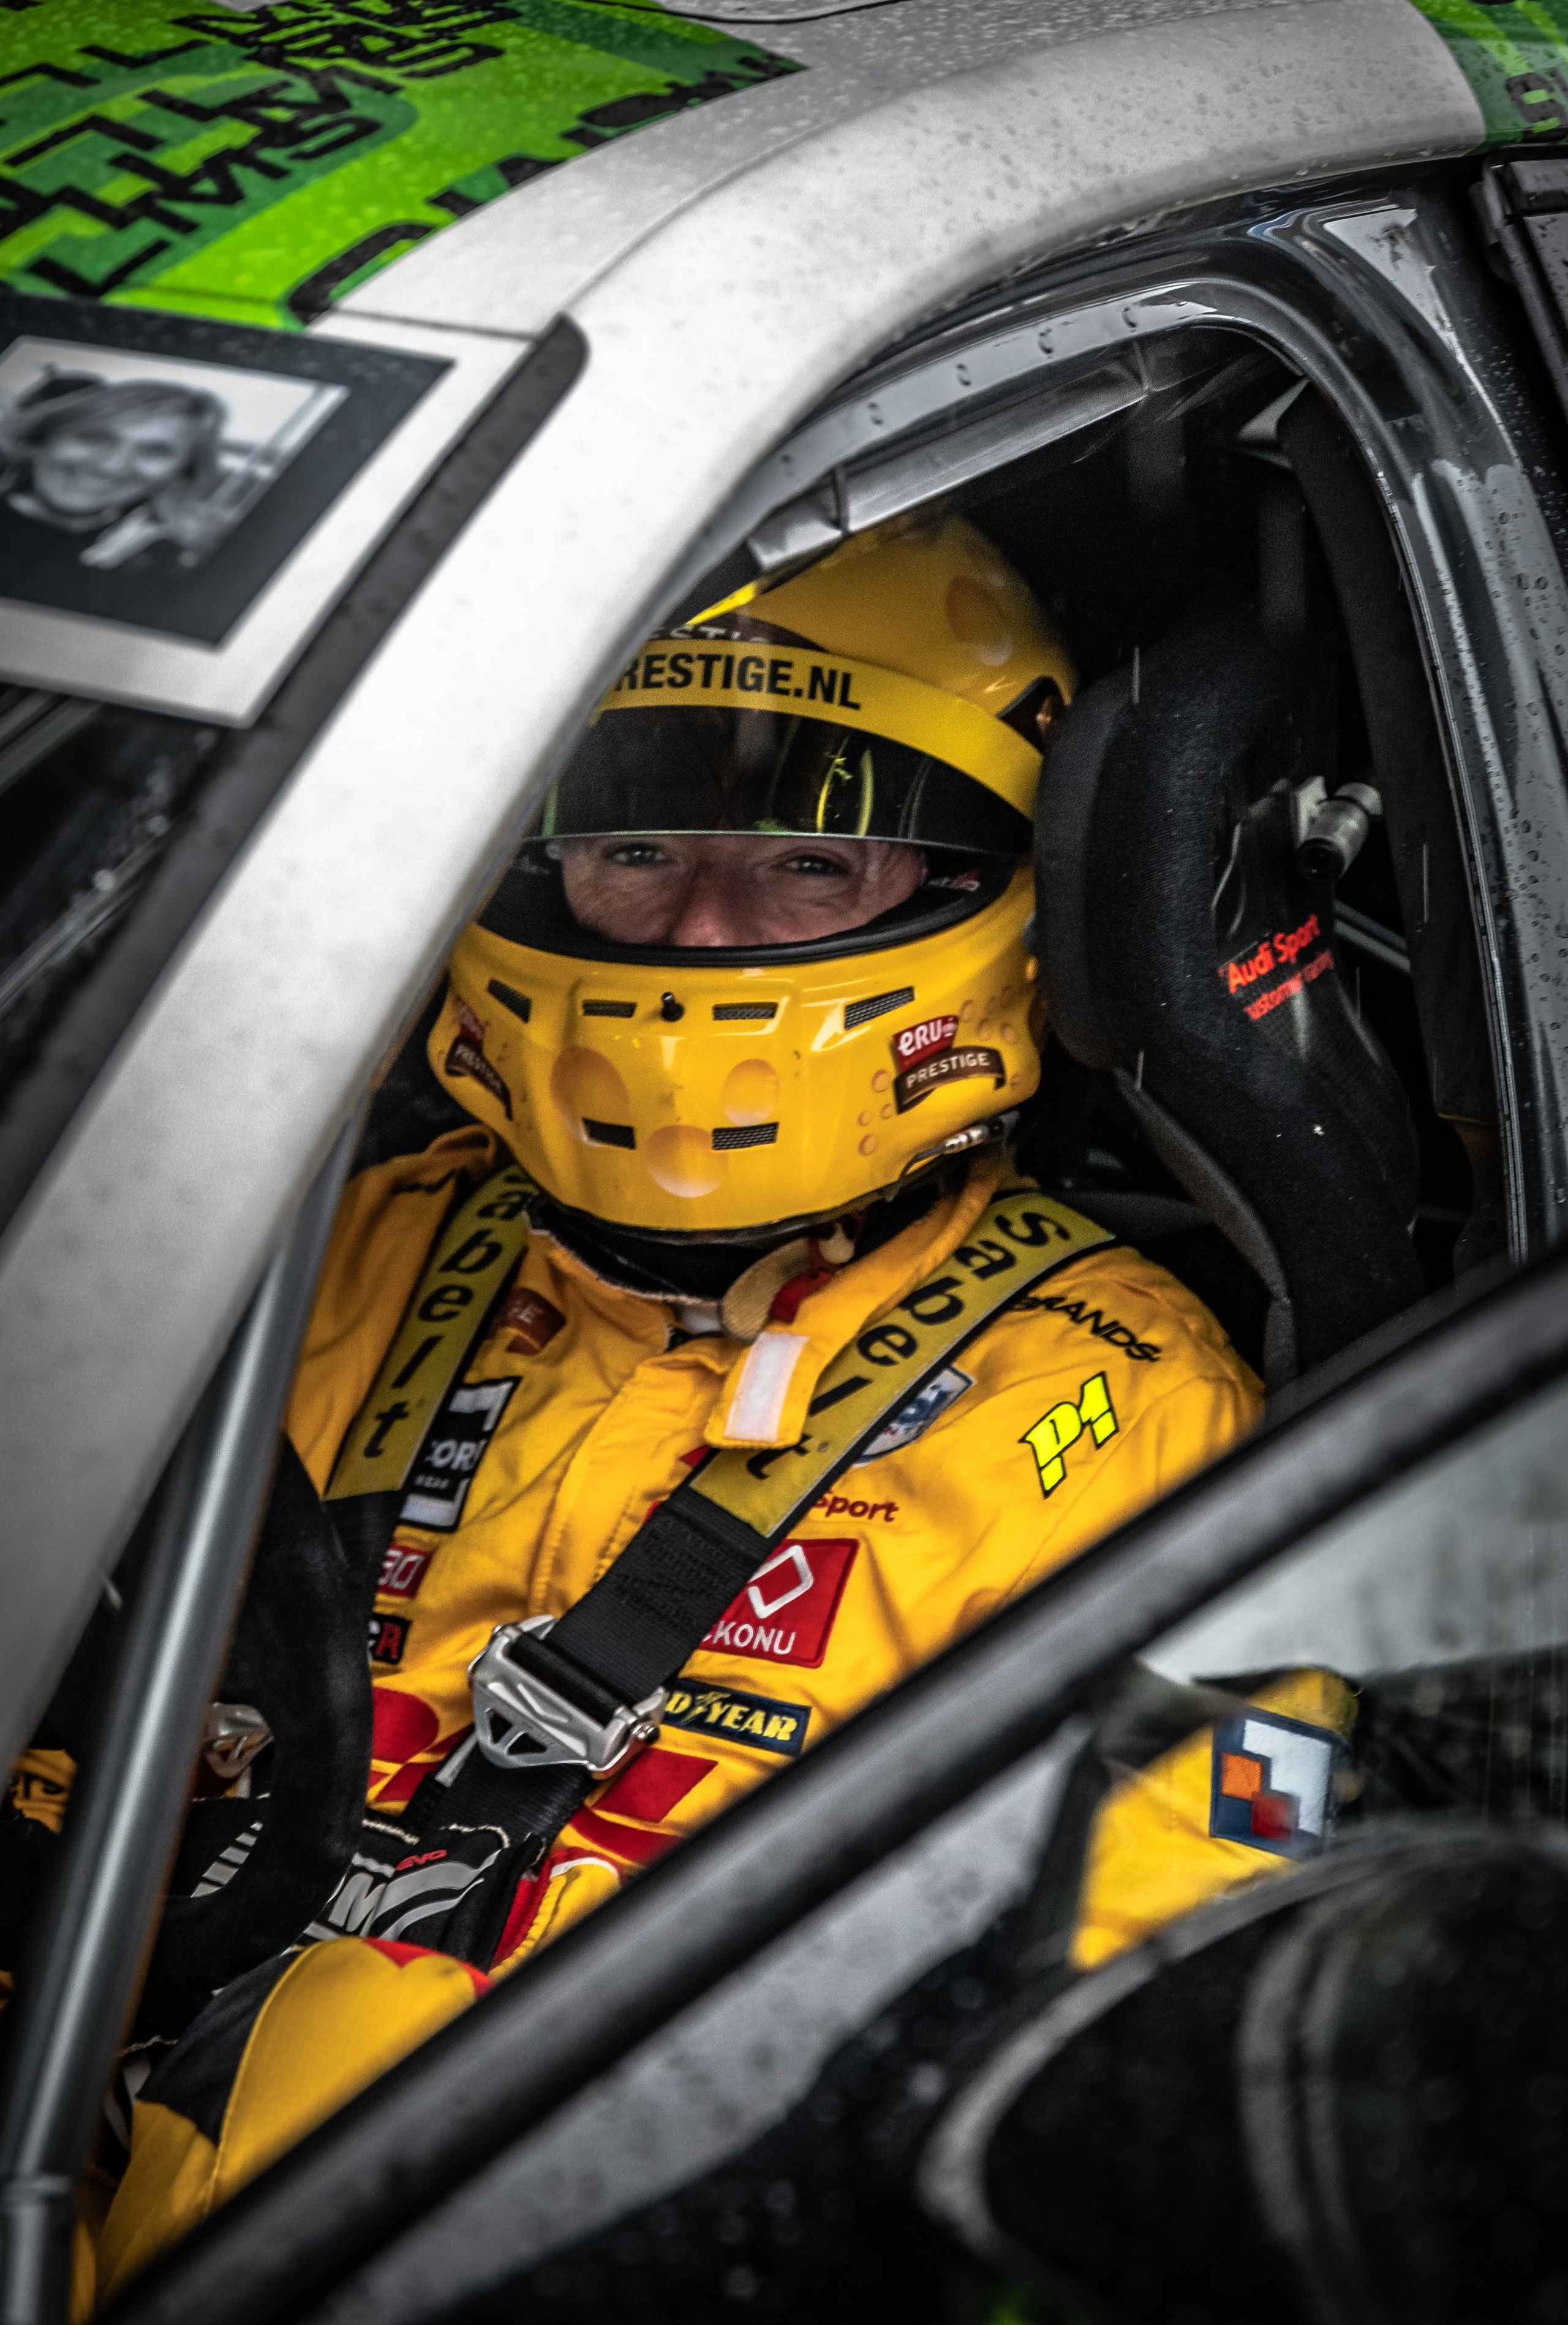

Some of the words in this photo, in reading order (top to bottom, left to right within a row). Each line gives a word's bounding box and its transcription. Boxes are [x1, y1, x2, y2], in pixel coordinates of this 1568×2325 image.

[1227, 942, 1275, 994] Audi
[1273, 914, 1321, 964] Sport
[905, 1052, 991, 1089] PRESTIGE
[362, 1171, 532, 1459] abelt
[702, 1620, 797, 1655] KONU
